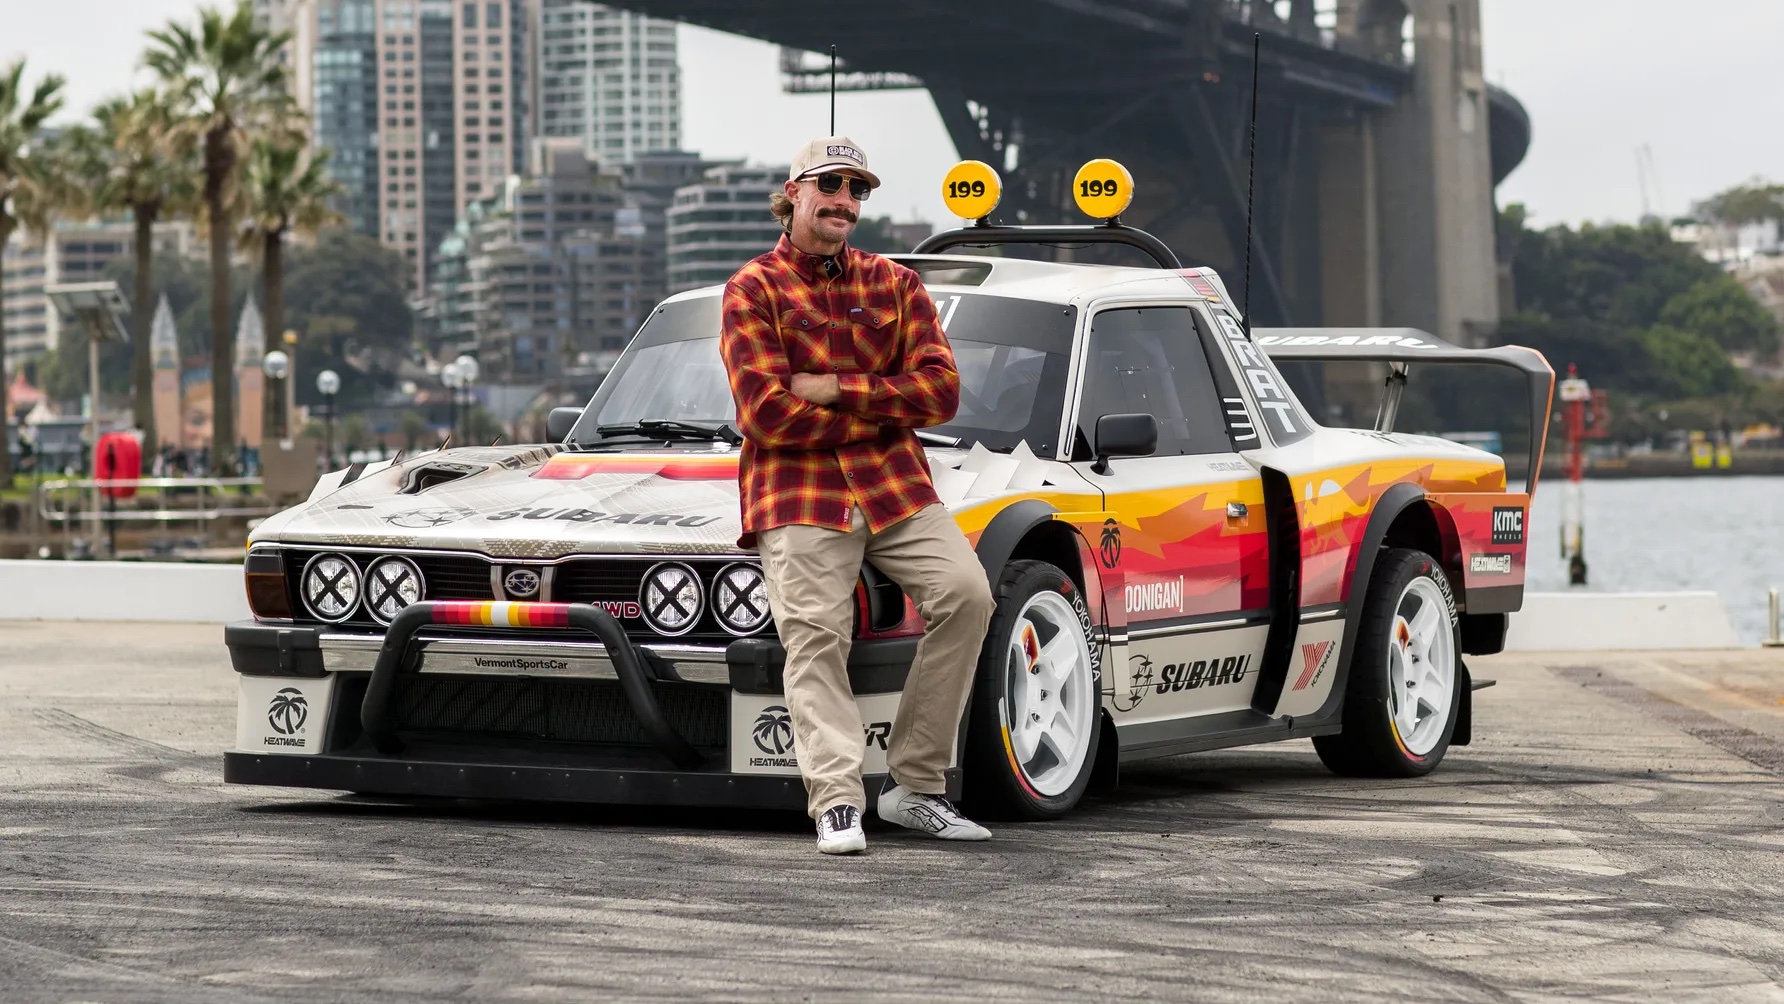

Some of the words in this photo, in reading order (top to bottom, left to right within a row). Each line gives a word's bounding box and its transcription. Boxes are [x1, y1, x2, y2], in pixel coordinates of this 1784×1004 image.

[948, 180, 985, 198] 199
[1080, 179, 1118, 197] 199
[1256, 335, 1438, 349] UBARU
[1216, 314, 1297, 434] BRAT
[487, 507, 723, 527] SUBARU
[1493, 511, 1522, 532] KMC
[1430, 564, 1459, 628] YOKOHAMA
[1072, 590, 1101, 682] YOKOHAMA
[474, 657, 568, 670] VermontSportsCar
[1156, 654, 1252, 694] SUBARU
[263, 736, 306, 747] HEATWAVE
[749, 757, 799, 767] HEATWAVE
